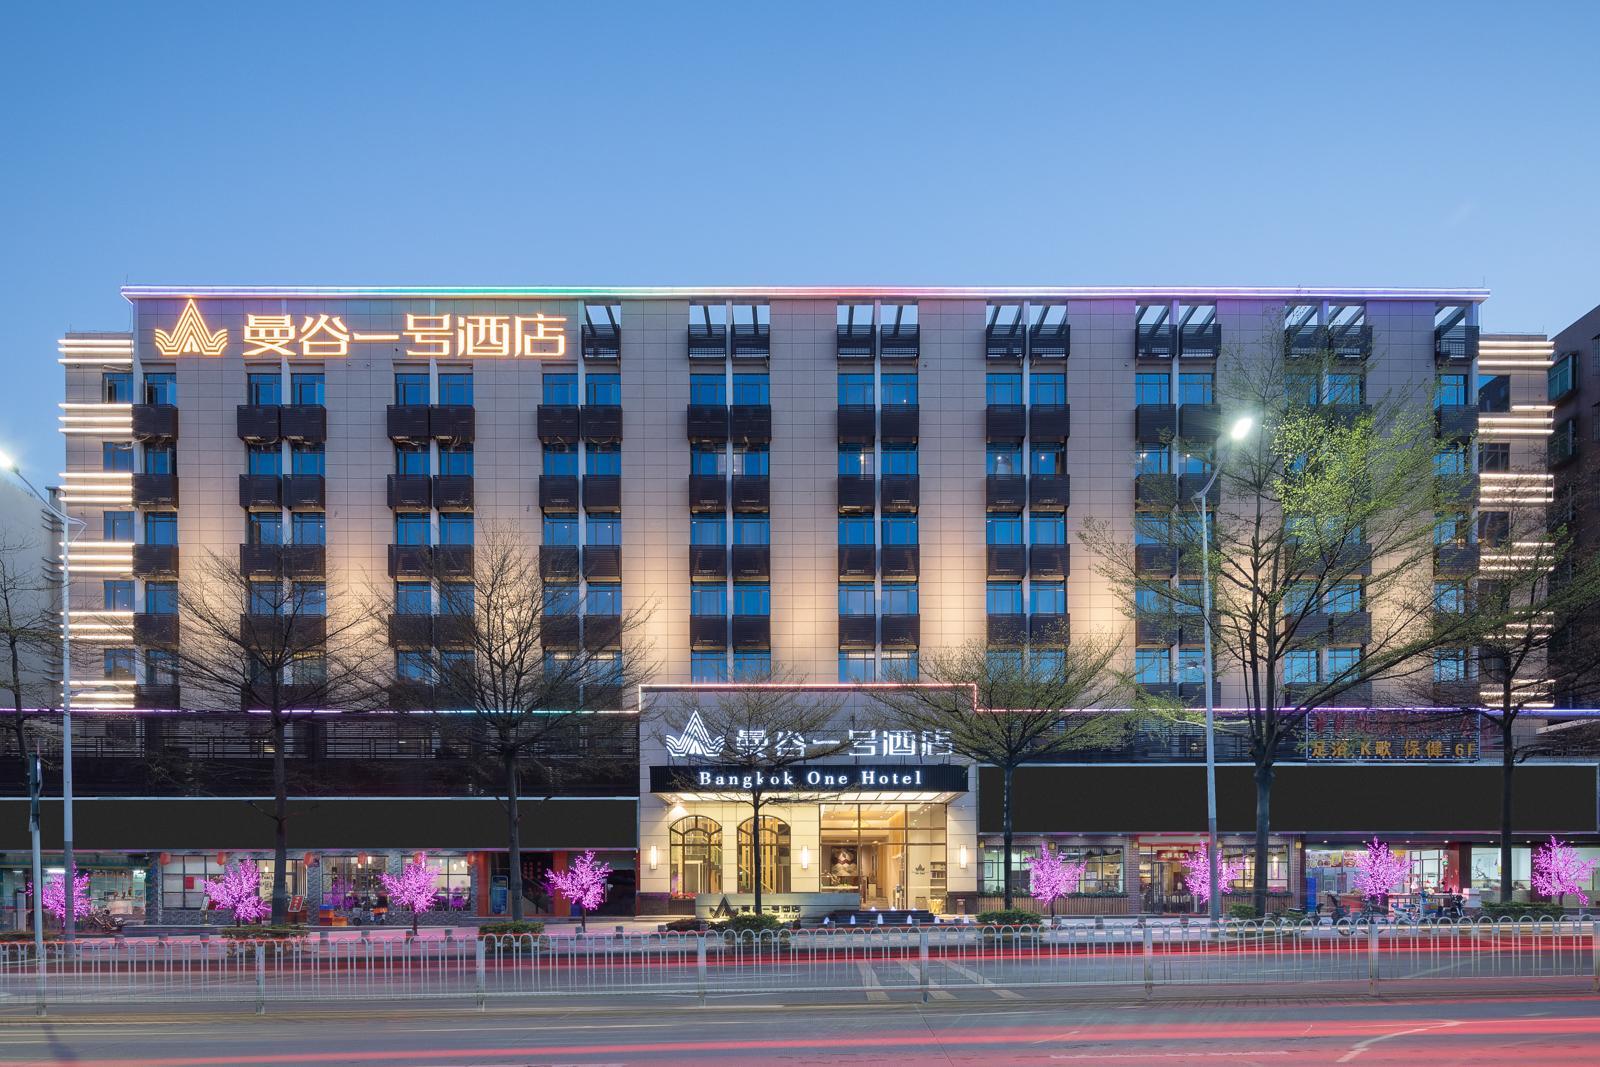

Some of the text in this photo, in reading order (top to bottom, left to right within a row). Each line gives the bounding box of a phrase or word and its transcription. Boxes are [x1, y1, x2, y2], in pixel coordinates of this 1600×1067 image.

[243, 313, 567, 357] 曼谷一号酒店
[736, 729, 953, 757] 曼谷一号酒店
[1311, 741, 1348, 757] 足浴
[1404, 740, 1444, 757] 保健
[1455, 743, 1477, 757] 6F
[700, 771, 922, 788] Bangkok One Hotel
